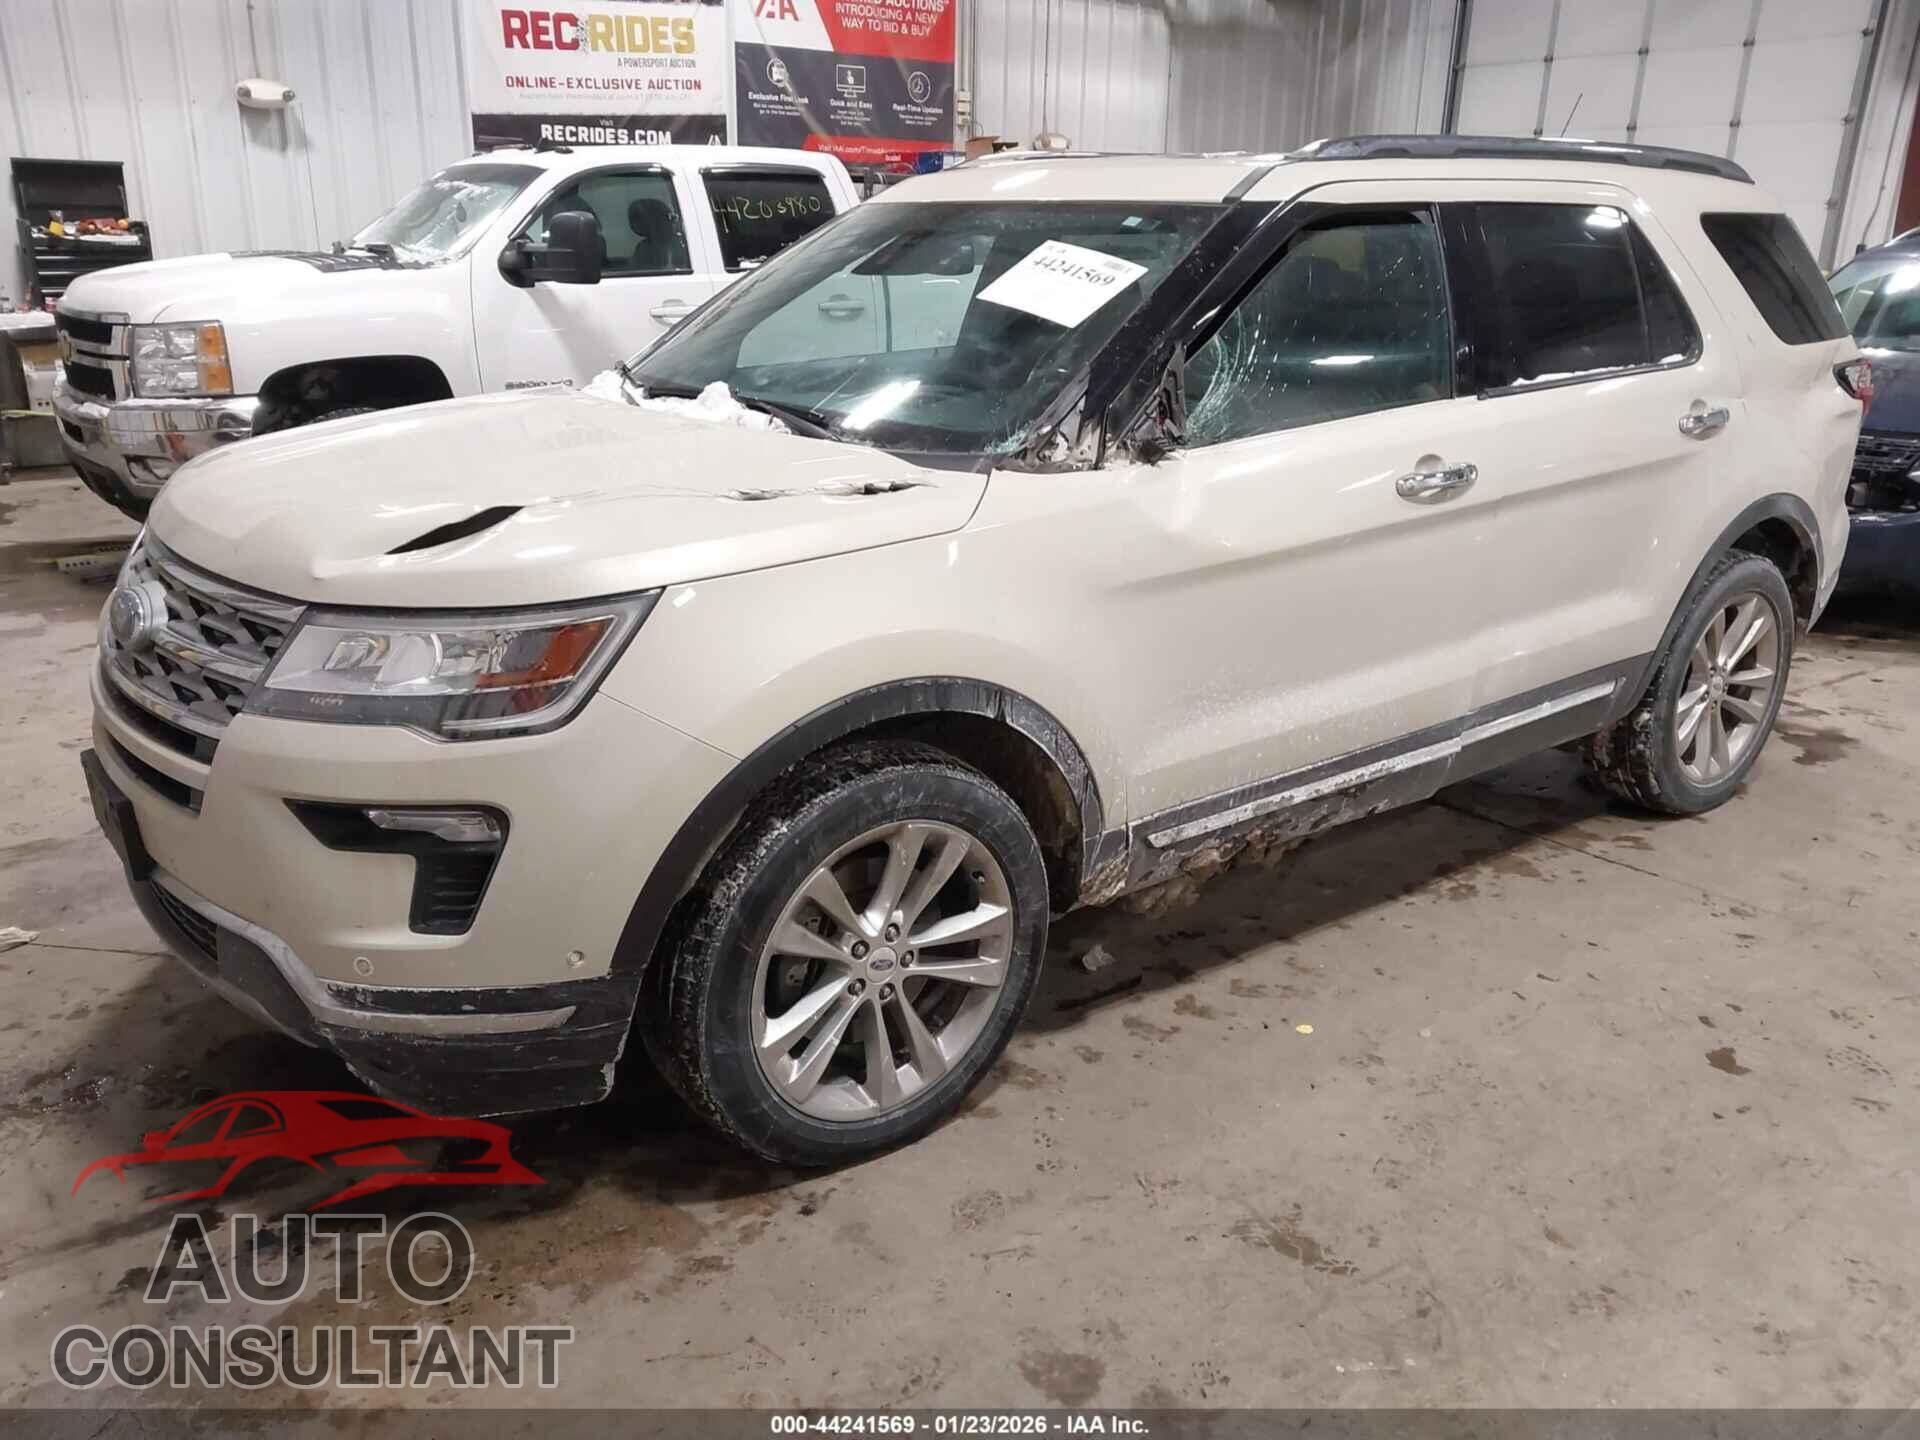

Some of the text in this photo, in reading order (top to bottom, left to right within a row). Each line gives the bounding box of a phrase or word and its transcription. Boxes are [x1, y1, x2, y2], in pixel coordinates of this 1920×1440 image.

[835, 3, 938, 24] INTRODUCING A NEW
[841, 16, 931, 36] WAY TO BID & BUY
[617, 57, 696, 69] A POWERSPORT AUCTION
[505, 75, 702, 91] ONLINE-EXCLUSIVE AUCTION
[541, 123, 671, 145] RECRIDES.COM
[1033, 255, 1117, 286] 44241569
